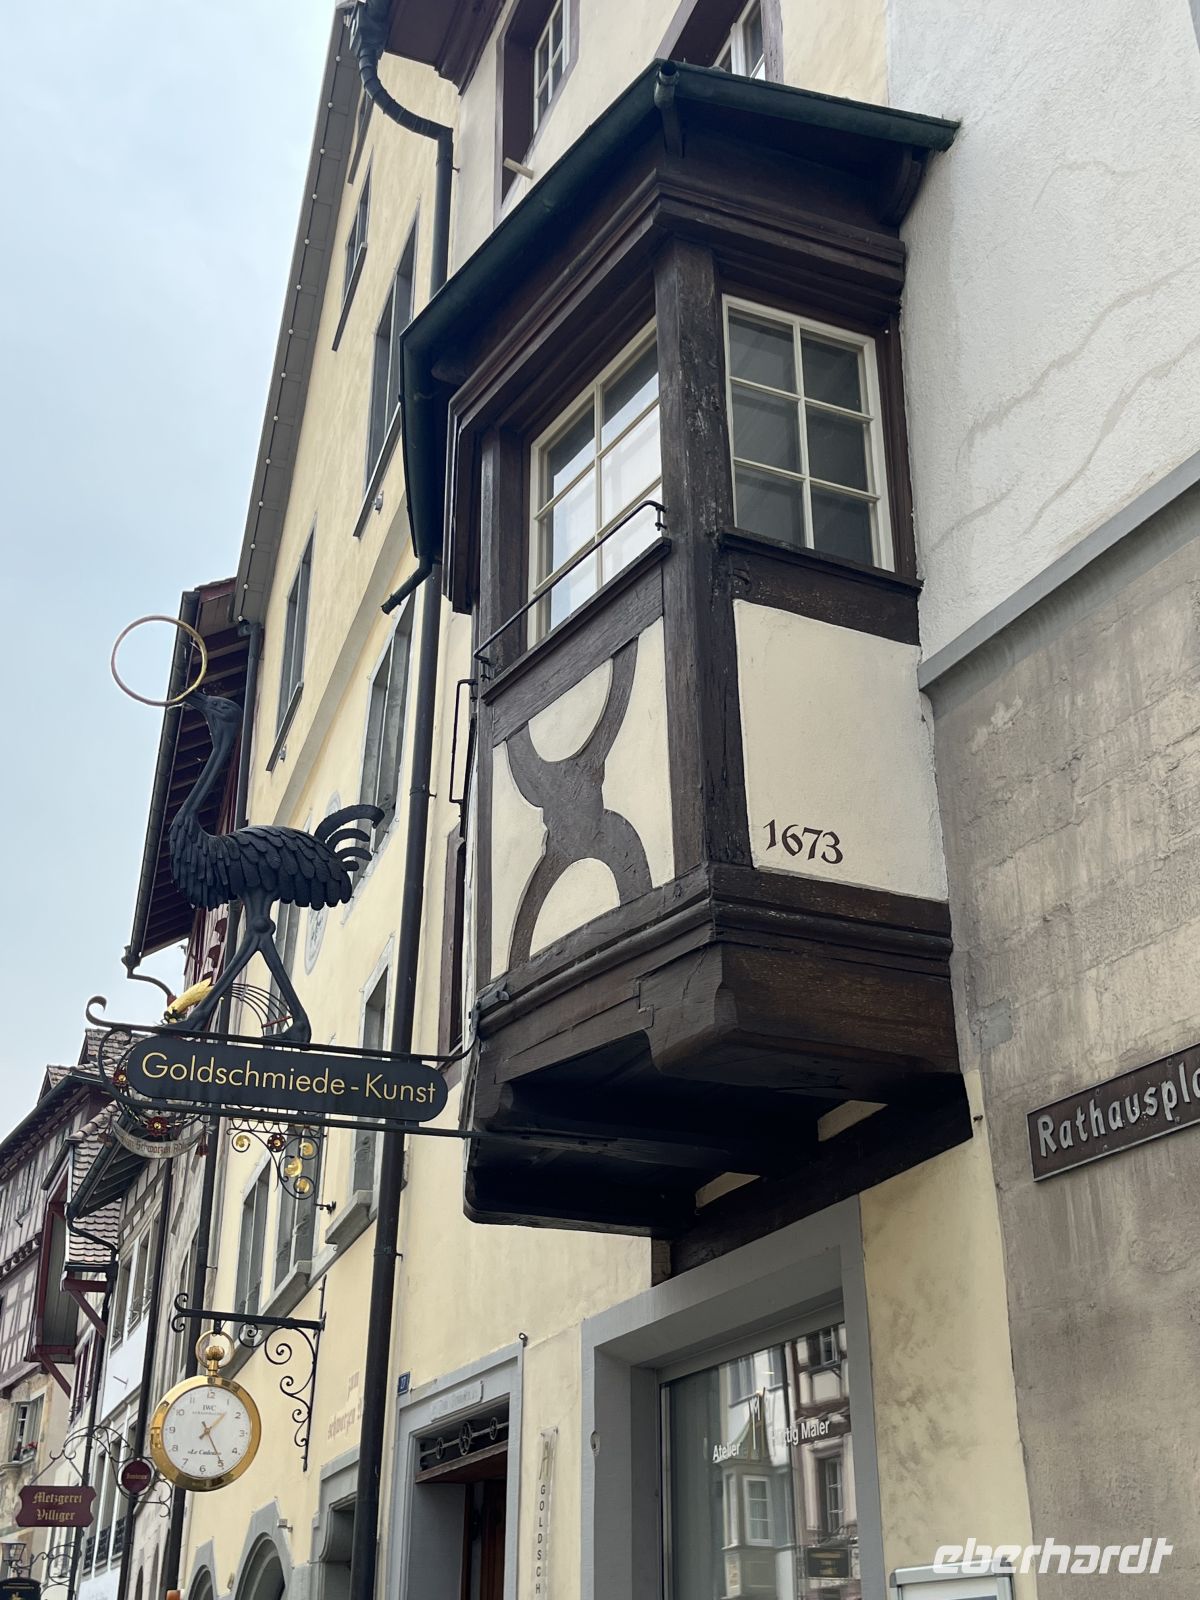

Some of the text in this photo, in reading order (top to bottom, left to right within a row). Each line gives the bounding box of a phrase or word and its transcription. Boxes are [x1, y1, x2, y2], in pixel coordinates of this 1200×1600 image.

[763, 819, 844, 865] 1673
[207, 1391, 216, 1399] 12
[175, 1408, 185, 1416] 10
[202, 1404, 216, 1412] IWC
[234, 1411, 241, 1419] 2
[168, 1426, 176, 1434] 9
[239, 1429, 245, 1437] 3
[712, 1441, 741, 1461] Atelier
[801, 1419, 830, 1440] Maier
[171, 1444, 179, 1452] 8
[231, 1447, 238, 1455] 4
[182, 1457, 189, 1466] 7
[217, 1459, 224, 1468] 5
[199, 1464, 206, 1473] 6
[32, 1491, 82, 1504] Metzgerei
[36, 1508, 76, 1523] Villiger
[535, 1484, 546, 1594] GOLDSCH
